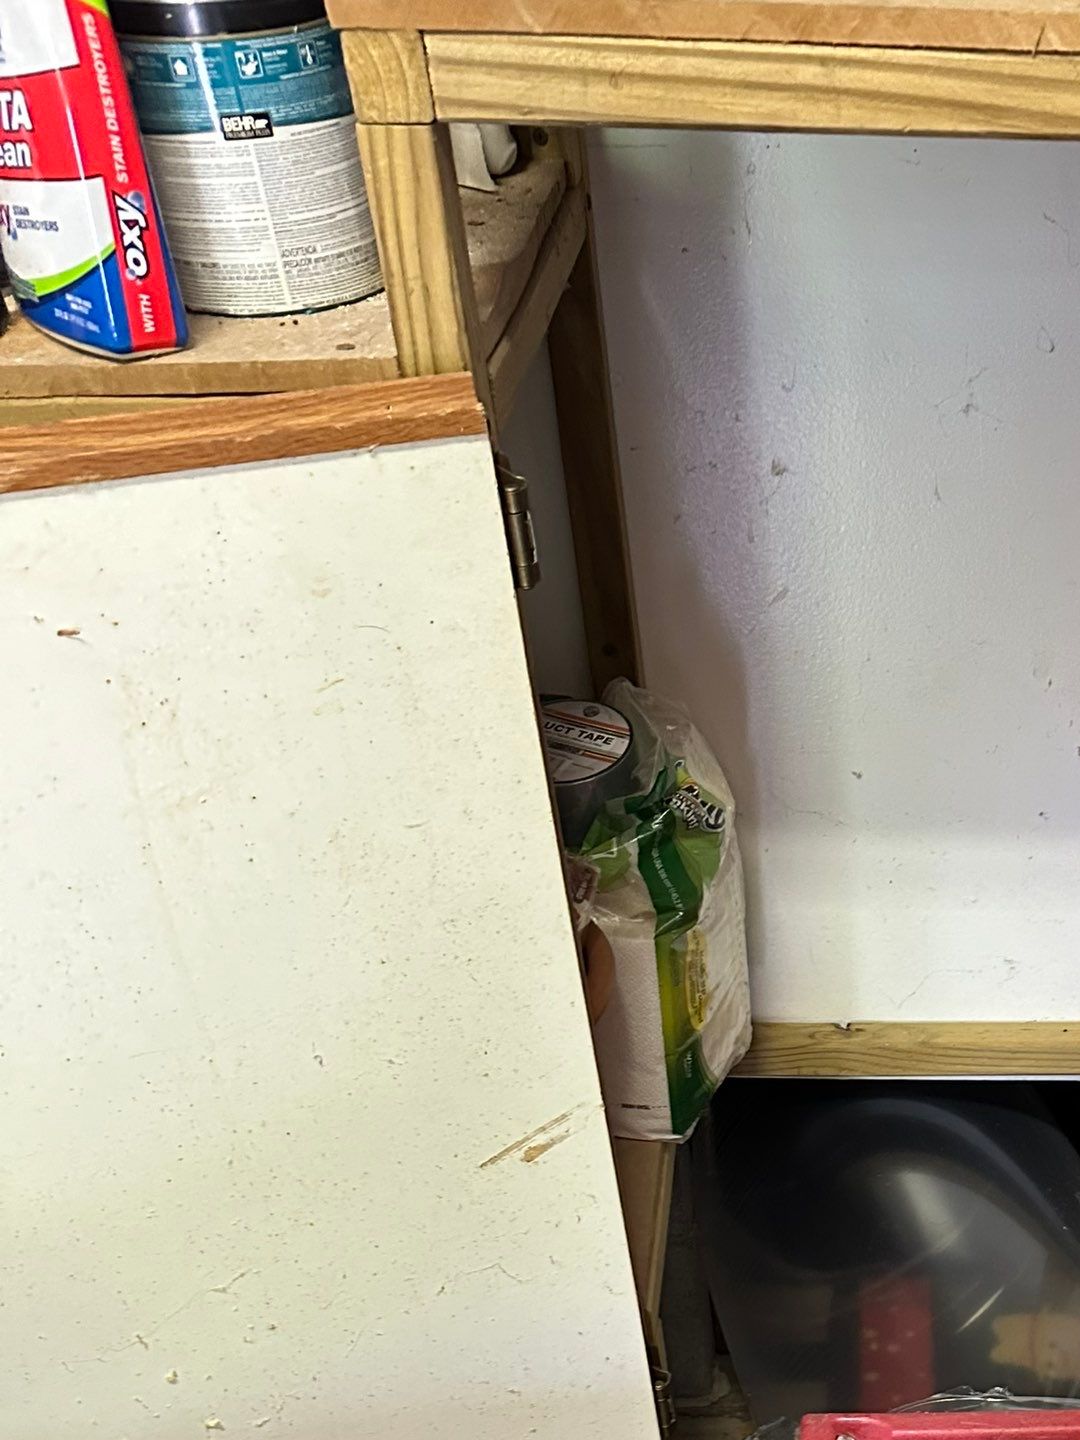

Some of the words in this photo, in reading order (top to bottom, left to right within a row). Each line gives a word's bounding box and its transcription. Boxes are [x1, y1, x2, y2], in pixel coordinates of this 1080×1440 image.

[81, 11, 120, 131] DESTROYERS
[221, 115, 257, 132] BEHR
[108, 132, 129, 184] STAIN
[139, 293, 156, 333] WITH
[577, 729, 616, 746] TAPE
